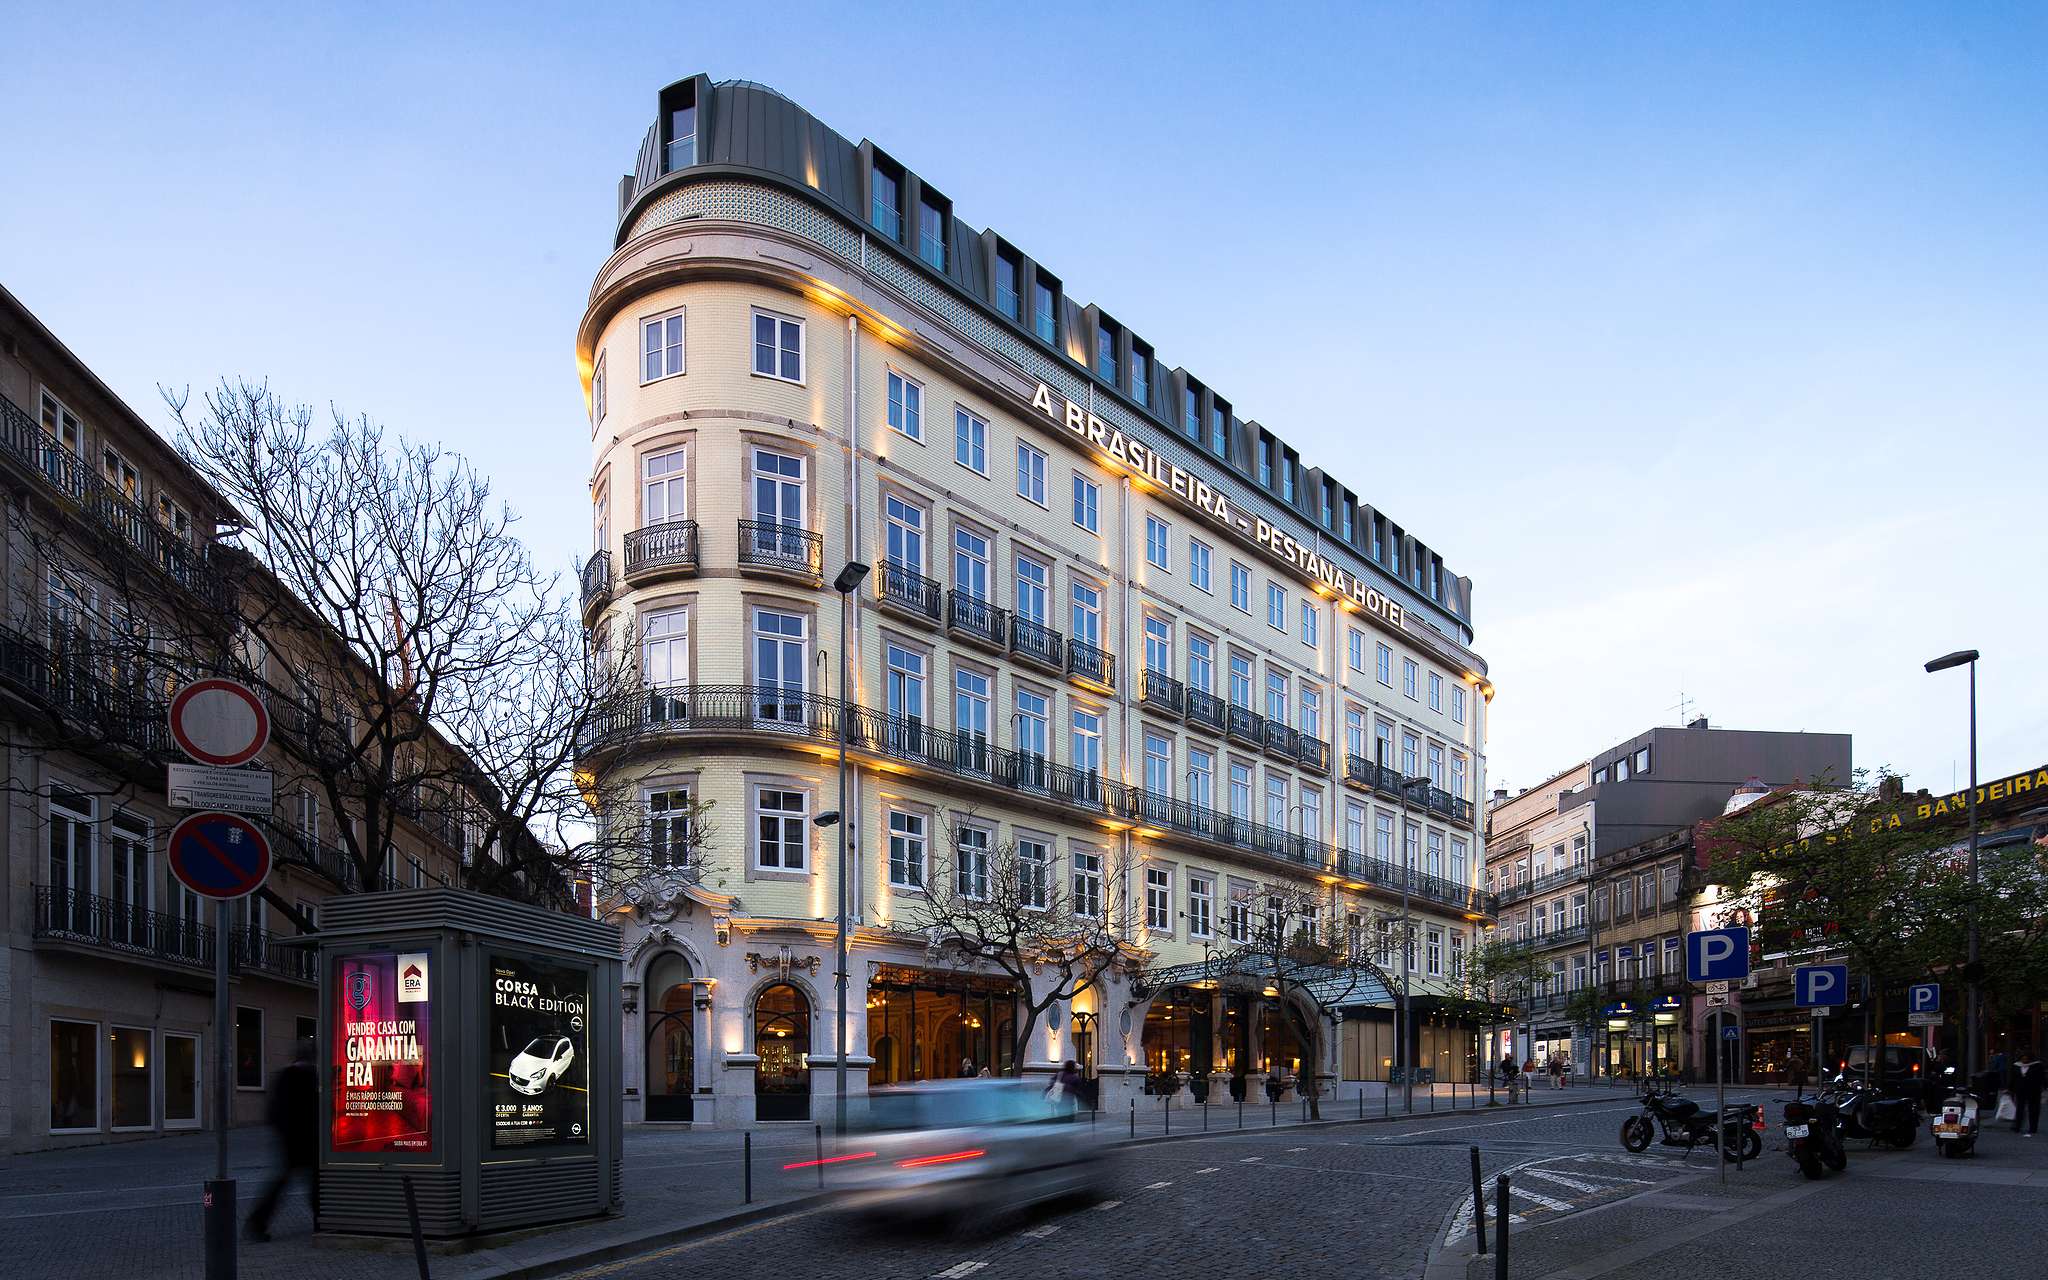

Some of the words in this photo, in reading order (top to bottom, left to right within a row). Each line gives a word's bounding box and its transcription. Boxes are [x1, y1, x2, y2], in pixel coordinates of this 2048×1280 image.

[1031, 383, 1054, 418] A
[1065, 399, 1230, 524] BRASILEIRA
[1255, 517, 1346, 593] PESTANA
[1353, 578, 1409, 631] HOTEL
[1871, 813, 1902, 833] DA
[1700, 934, 1735, 977] P
[405, 979, 421, 988] ERA
[495, 979, 538, 996] CORSA
[1808, 970, 1835, 1003] P
[495, 992, 534, 1009] BLACK
[539, 998, 583, 1015] EDITION
[1915, 987, 1933, 1010] P
[347, 1021, 376, 1036] VENDER
[377, 1021, 398, 1035] CASA
[398, 1020, 416, 1034] COM
[346, 1035, 419, 1061] GARANTIA
[346, 1062, 373, 1087] ERA
[349, 1092, 360, 1101] MAIS
[361, 1090, 378, 1101] RÁPIDO
[381, 1091, 403, 1101] GARANTE
[350, 1101, 377, 1110] CERTIFICADO
[377, 1100, 403, 1110] ENERGÉTICO
